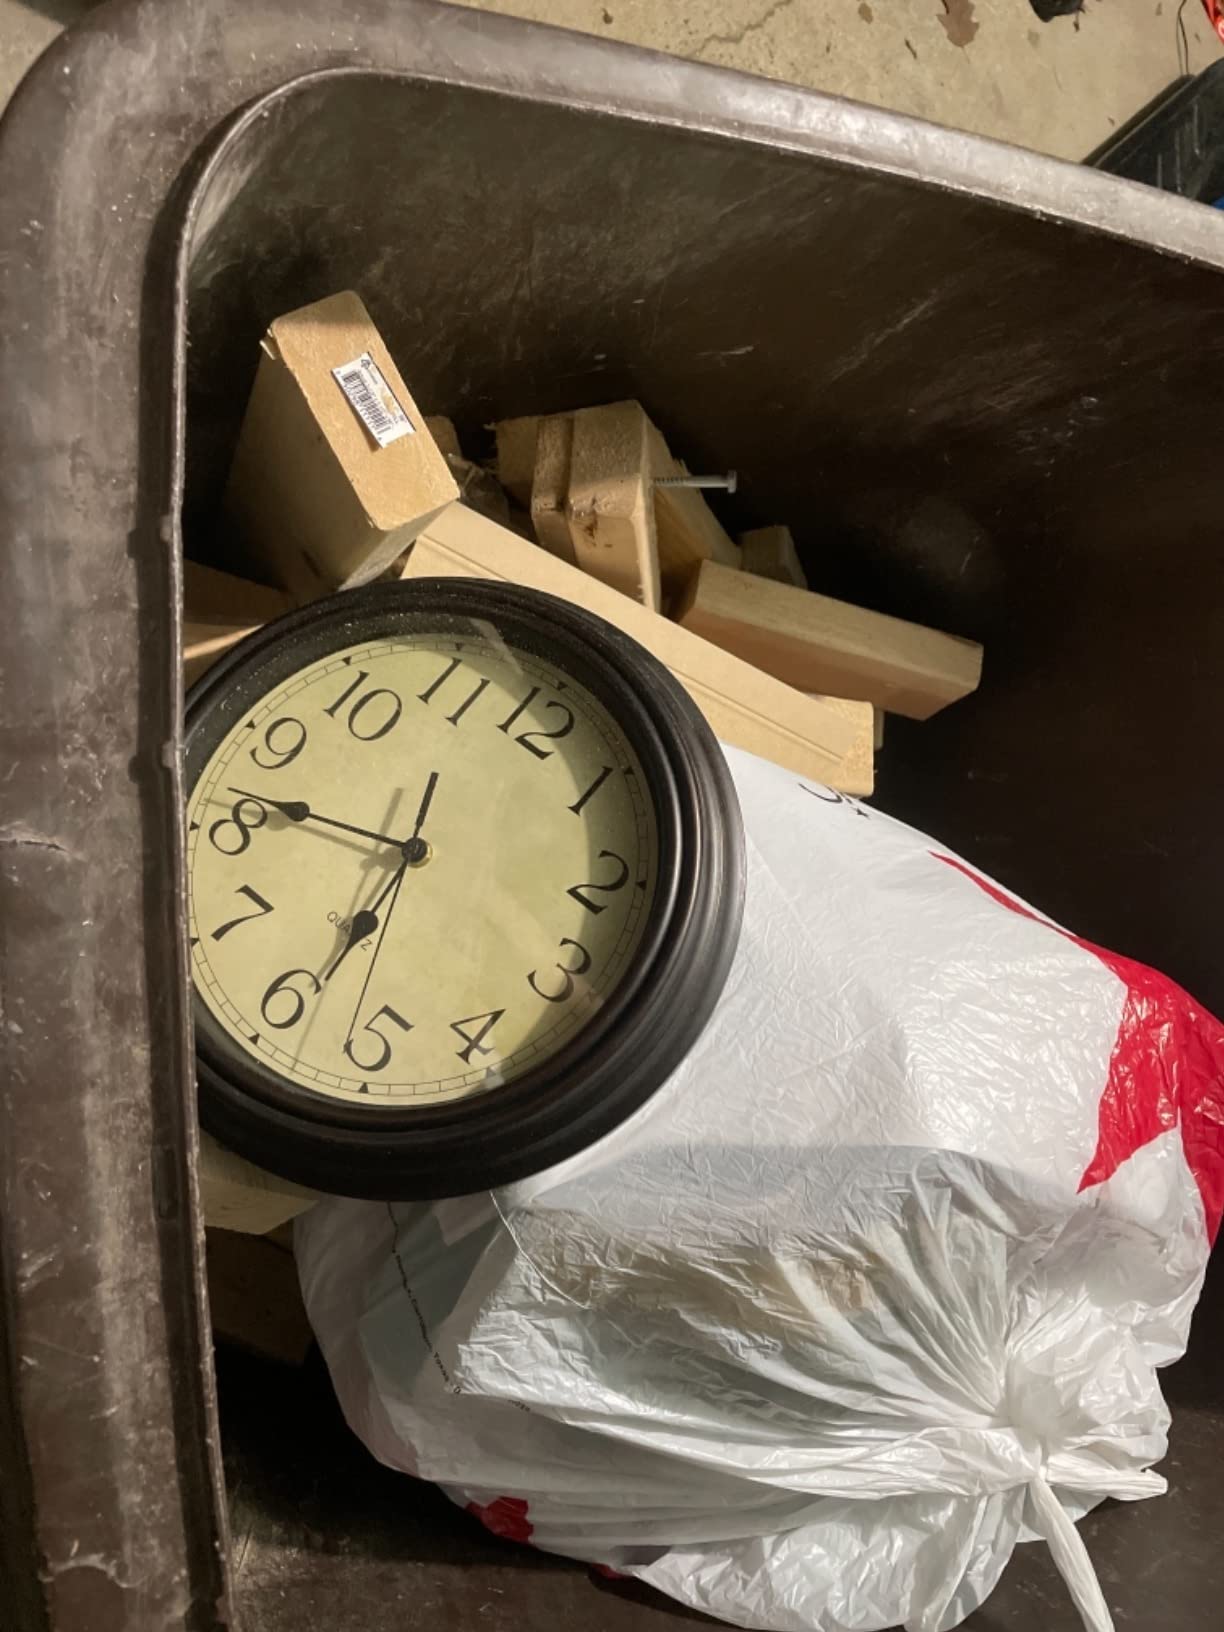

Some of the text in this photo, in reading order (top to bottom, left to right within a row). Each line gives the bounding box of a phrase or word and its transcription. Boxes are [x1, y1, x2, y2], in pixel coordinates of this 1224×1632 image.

[322, 671, 403, 741] 10
[416, 658, 491, 727] 11
[497, 686, 576, 761] 12
[249, 717, 308, 771] 9
[567, 766, 614, 817] 1
[208, 797, 268, 857] 8
[211, 884, 275, 942] 7
[566, 850, 630, 916] 2
[327, 911, 373, 952] QUAZ
[260, 968, 322, 1030] 6
[527, 937, 592, 1003] 3
[343, 1005, 415, 1073] 5
[449, 1008, 506, 1065] 4
